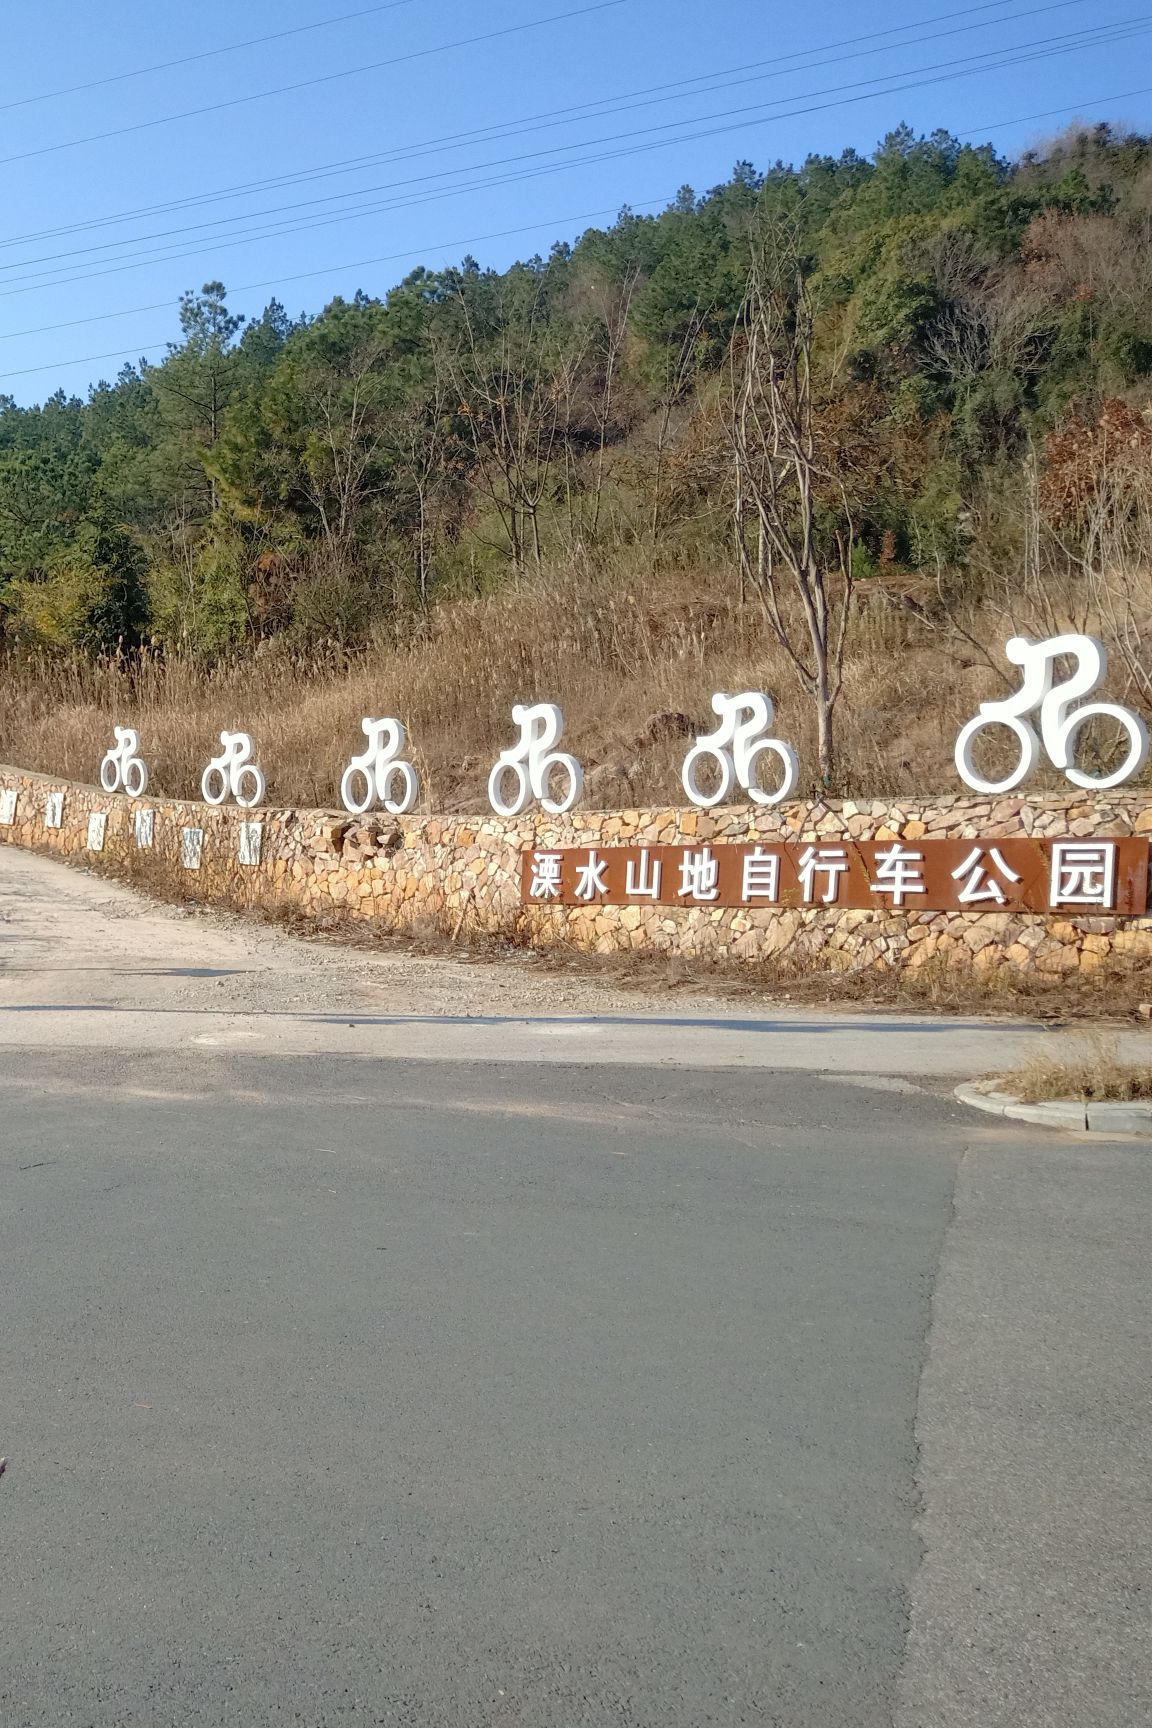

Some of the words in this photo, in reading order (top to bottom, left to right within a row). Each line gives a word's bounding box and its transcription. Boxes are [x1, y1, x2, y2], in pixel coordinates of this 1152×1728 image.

[529, 842, 1116, 908] 溧水山地自行车公园
